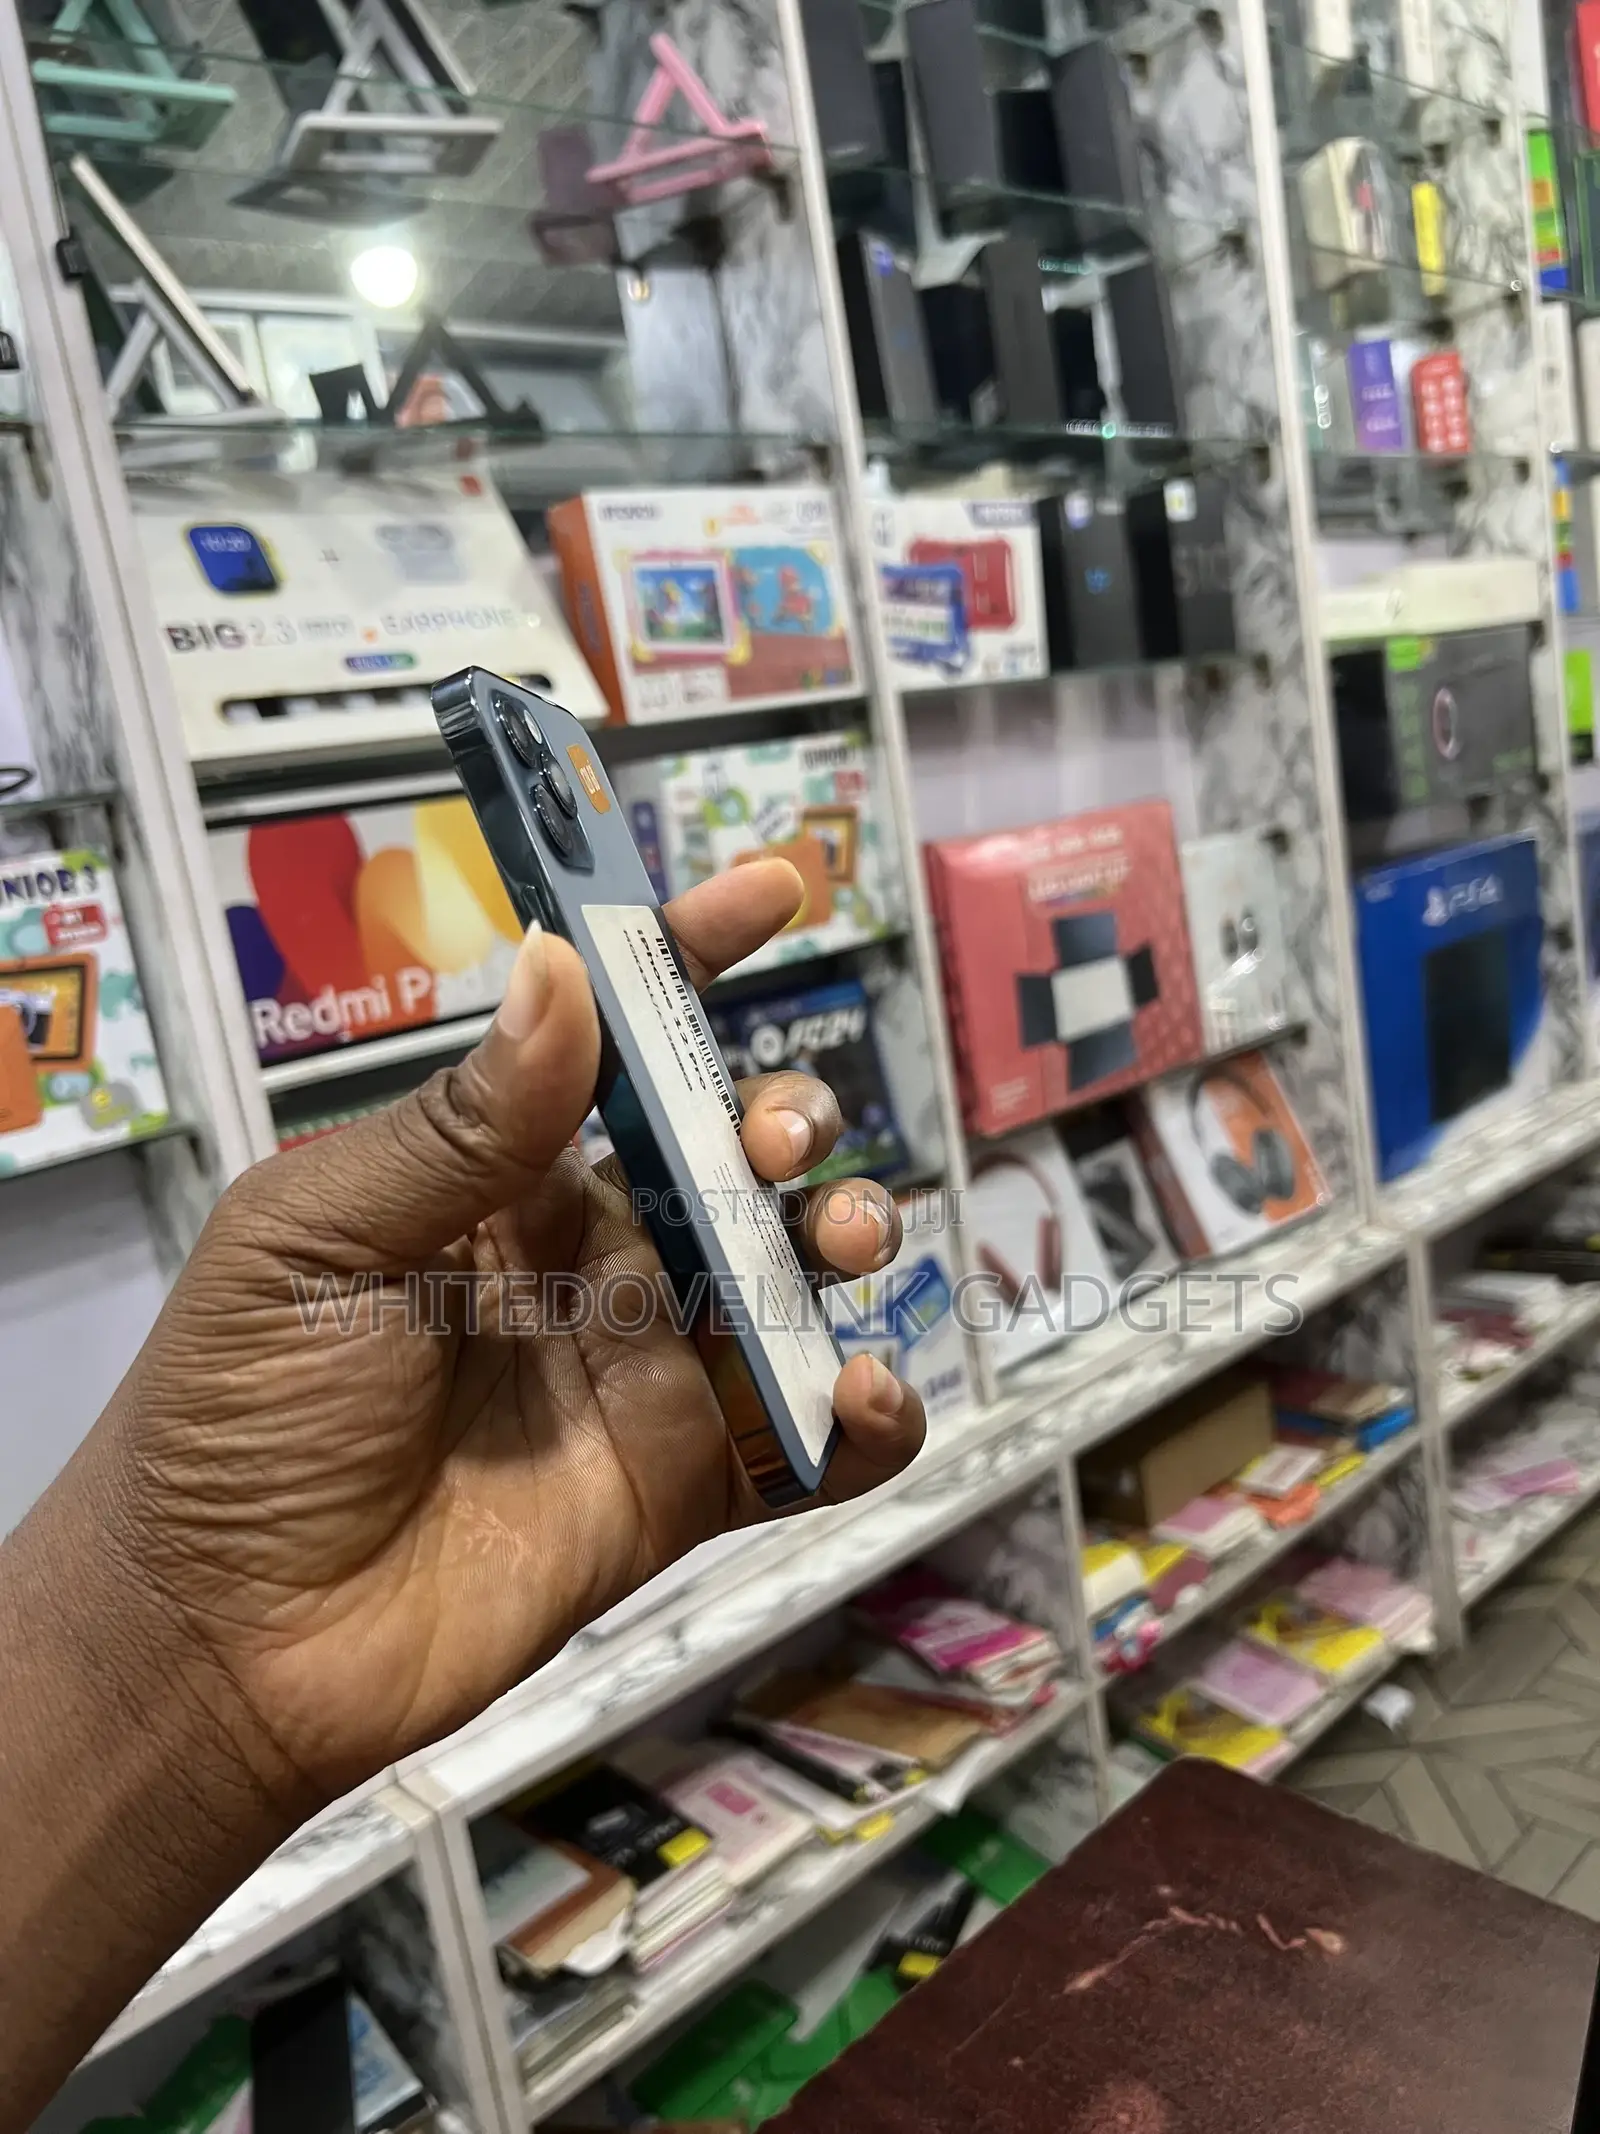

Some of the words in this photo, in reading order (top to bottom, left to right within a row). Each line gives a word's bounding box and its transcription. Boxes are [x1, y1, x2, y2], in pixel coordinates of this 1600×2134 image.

[167, 622, 246, 652] BIG
[251, 975, 391, 1048] Redmi
[637, 928, 673, 1010] iPhone
[673, 1016, 688, 1046] 12
[688, 1052, 706, 1091] Pro
